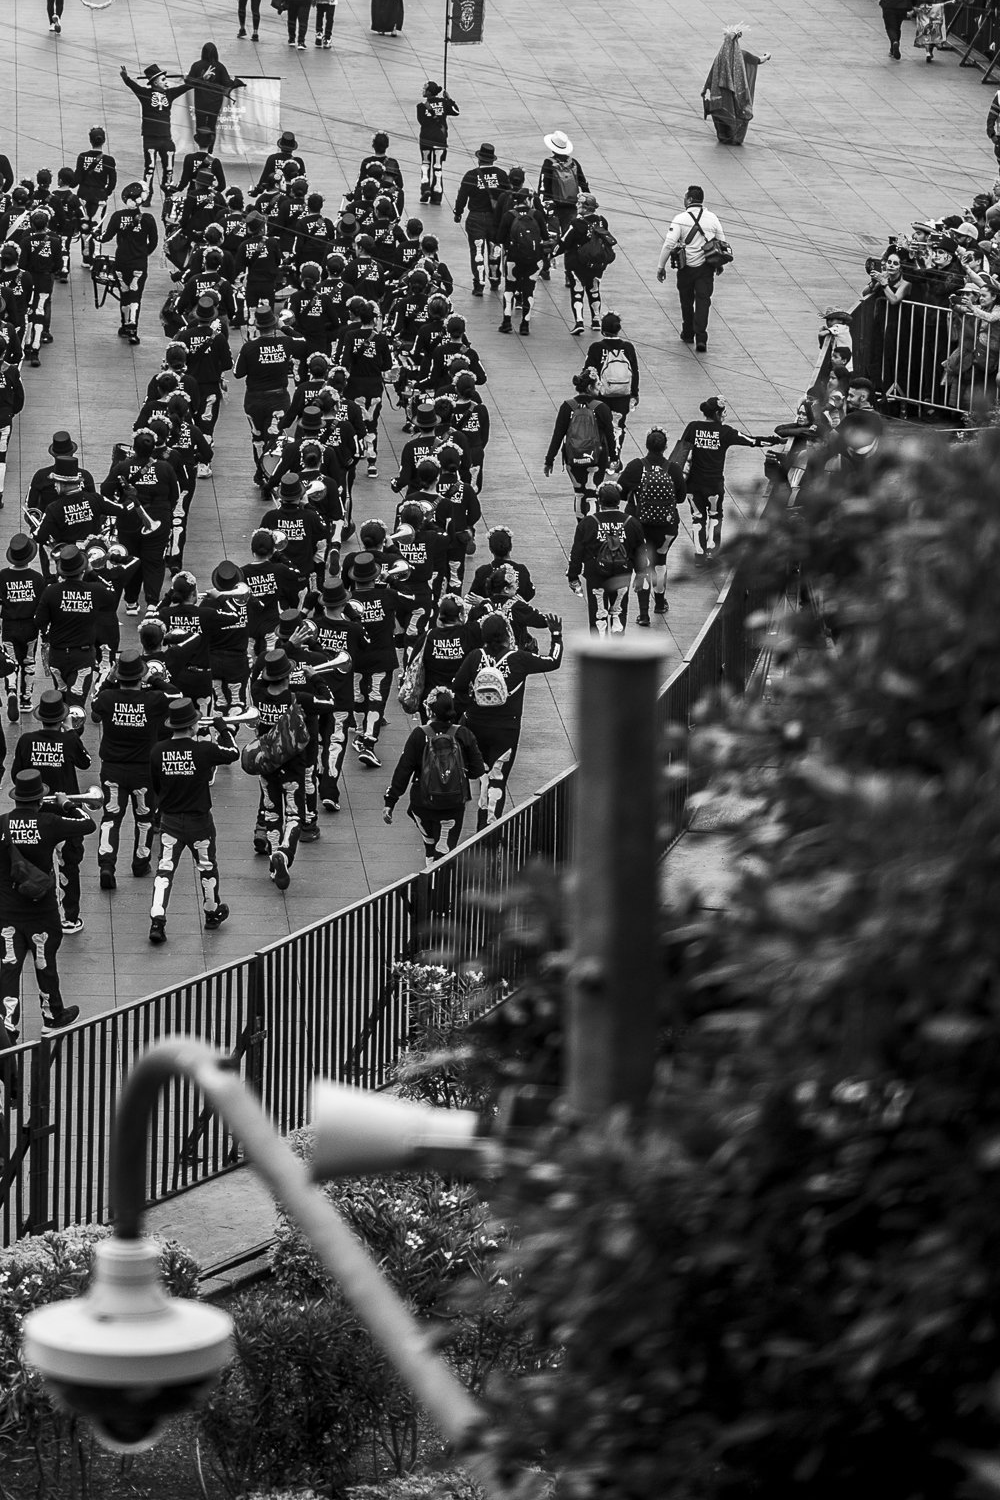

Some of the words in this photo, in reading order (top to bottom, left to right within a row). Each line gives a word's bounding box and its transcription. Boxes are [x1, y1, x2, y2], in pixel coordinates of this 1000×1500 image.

[260, 344, 284, 353] LINAJE
[258, 352, 287, 362] AZTECA
[696, 430, 720, 439] LINAJE
[694, 438, 721, 448] AZTECA
[63, 501, 91, 514] LINAJE
[64, 510, 94, 523] AZTECA
[278, 520, 304, 528] LINAJE
[247, 573, 276, 586] LINAJE
[6, 581, 33, 590] LINAJE
[6, 589, 36, 599] AZTECA
[63, 591, 92, 600] LINAJE
[60, 600, 93, 610] AZTECA
[170, 616, 200, 625] LINAJE
[318, 628, 348, 640] LINAJE
[433, 638, 461, 648] LINAJE
[432, 647, 465, 657] AZTECA
[115, 703, 145, 713] LINAJE
[258, 702, 288, 714] LINAJE
[112, 713, 147, 723] AZTECA
[32, 741, 63, 752] LINAJE
[30, 752, 65, 763] AZTECA
[162, 751, 193, 761] LINAJE
[162, 761, 196, 772] AZTECA
[9, 820, 37, 829] INAJE
